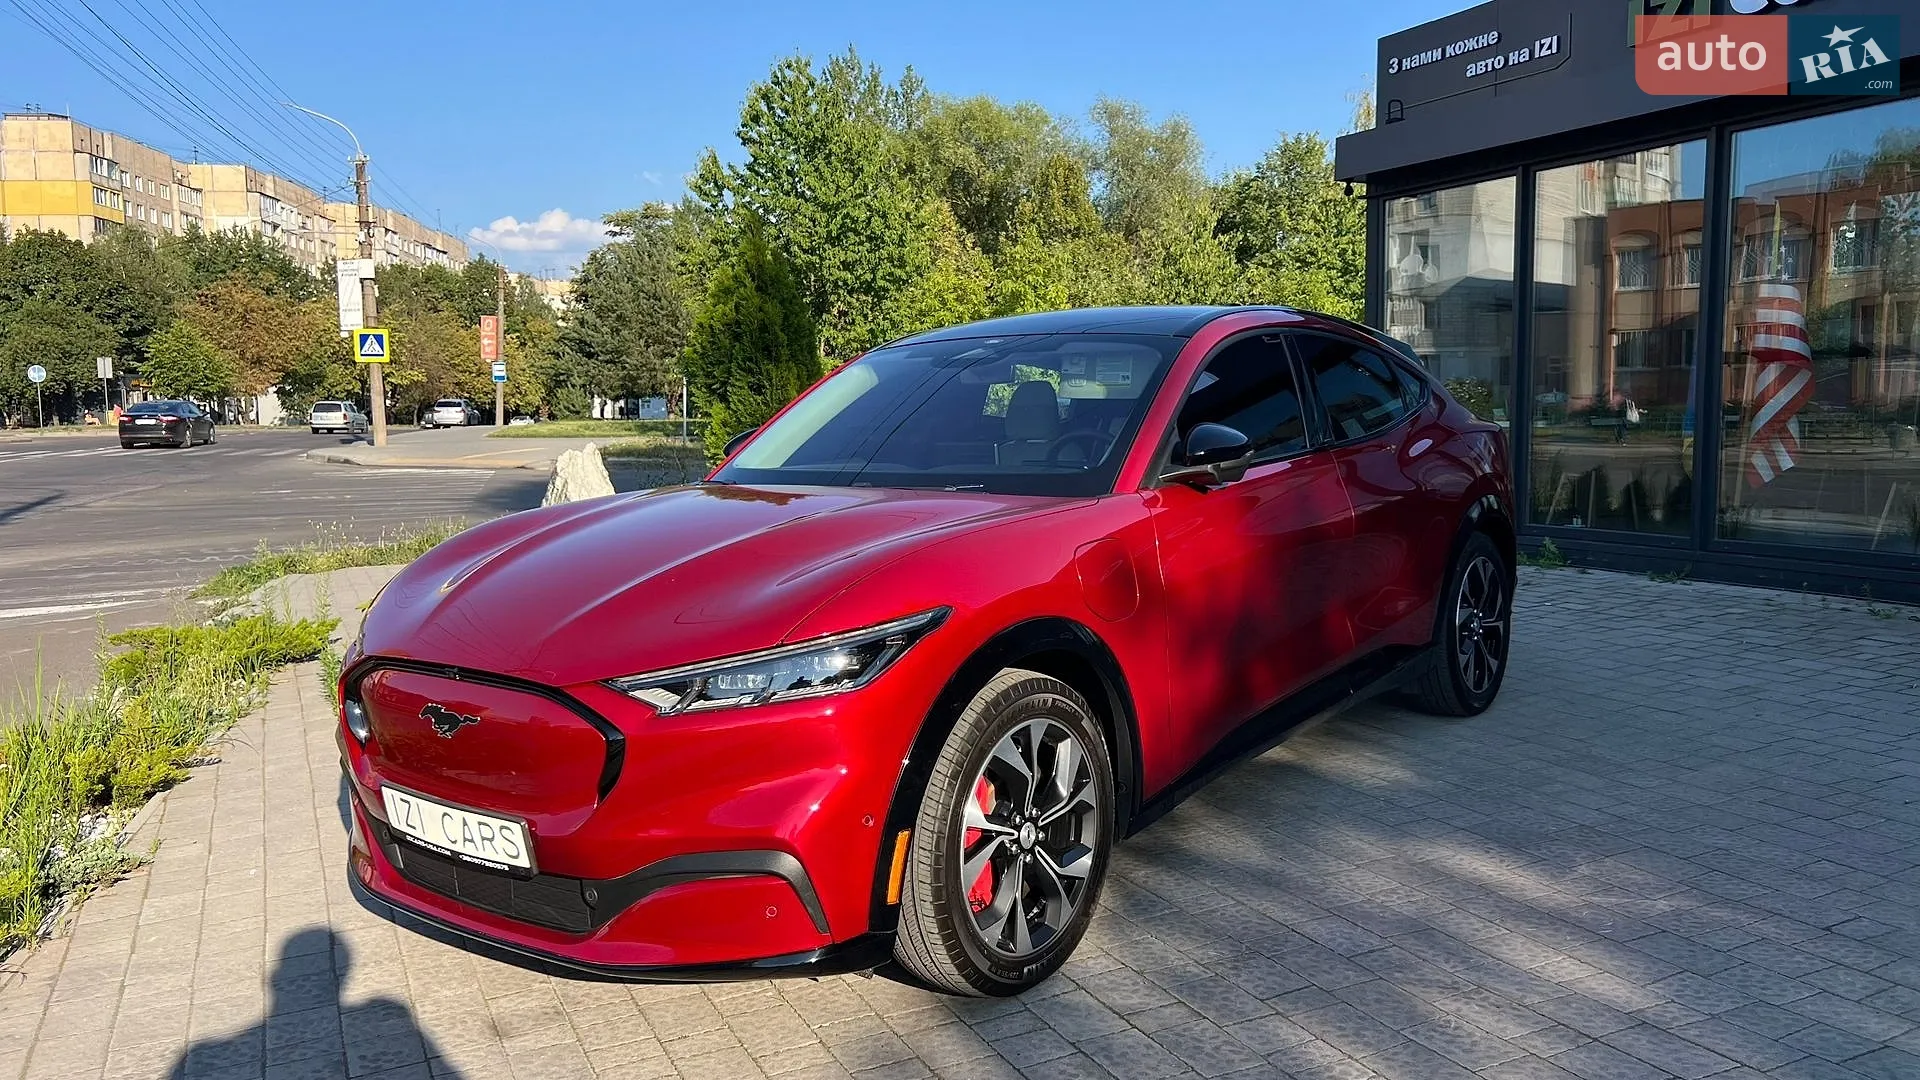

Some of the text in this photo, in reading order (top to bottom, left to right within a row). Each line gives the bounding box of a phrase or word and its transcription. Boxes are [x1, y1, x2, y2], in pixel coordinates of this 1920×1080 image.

[1401, 47, 1442, 71] нами
[1446, 30, 1498, 58] кожне
[1465, 35, 1558, 77] авто на IZI
[391, 793, 520, 860] IZI CARS
